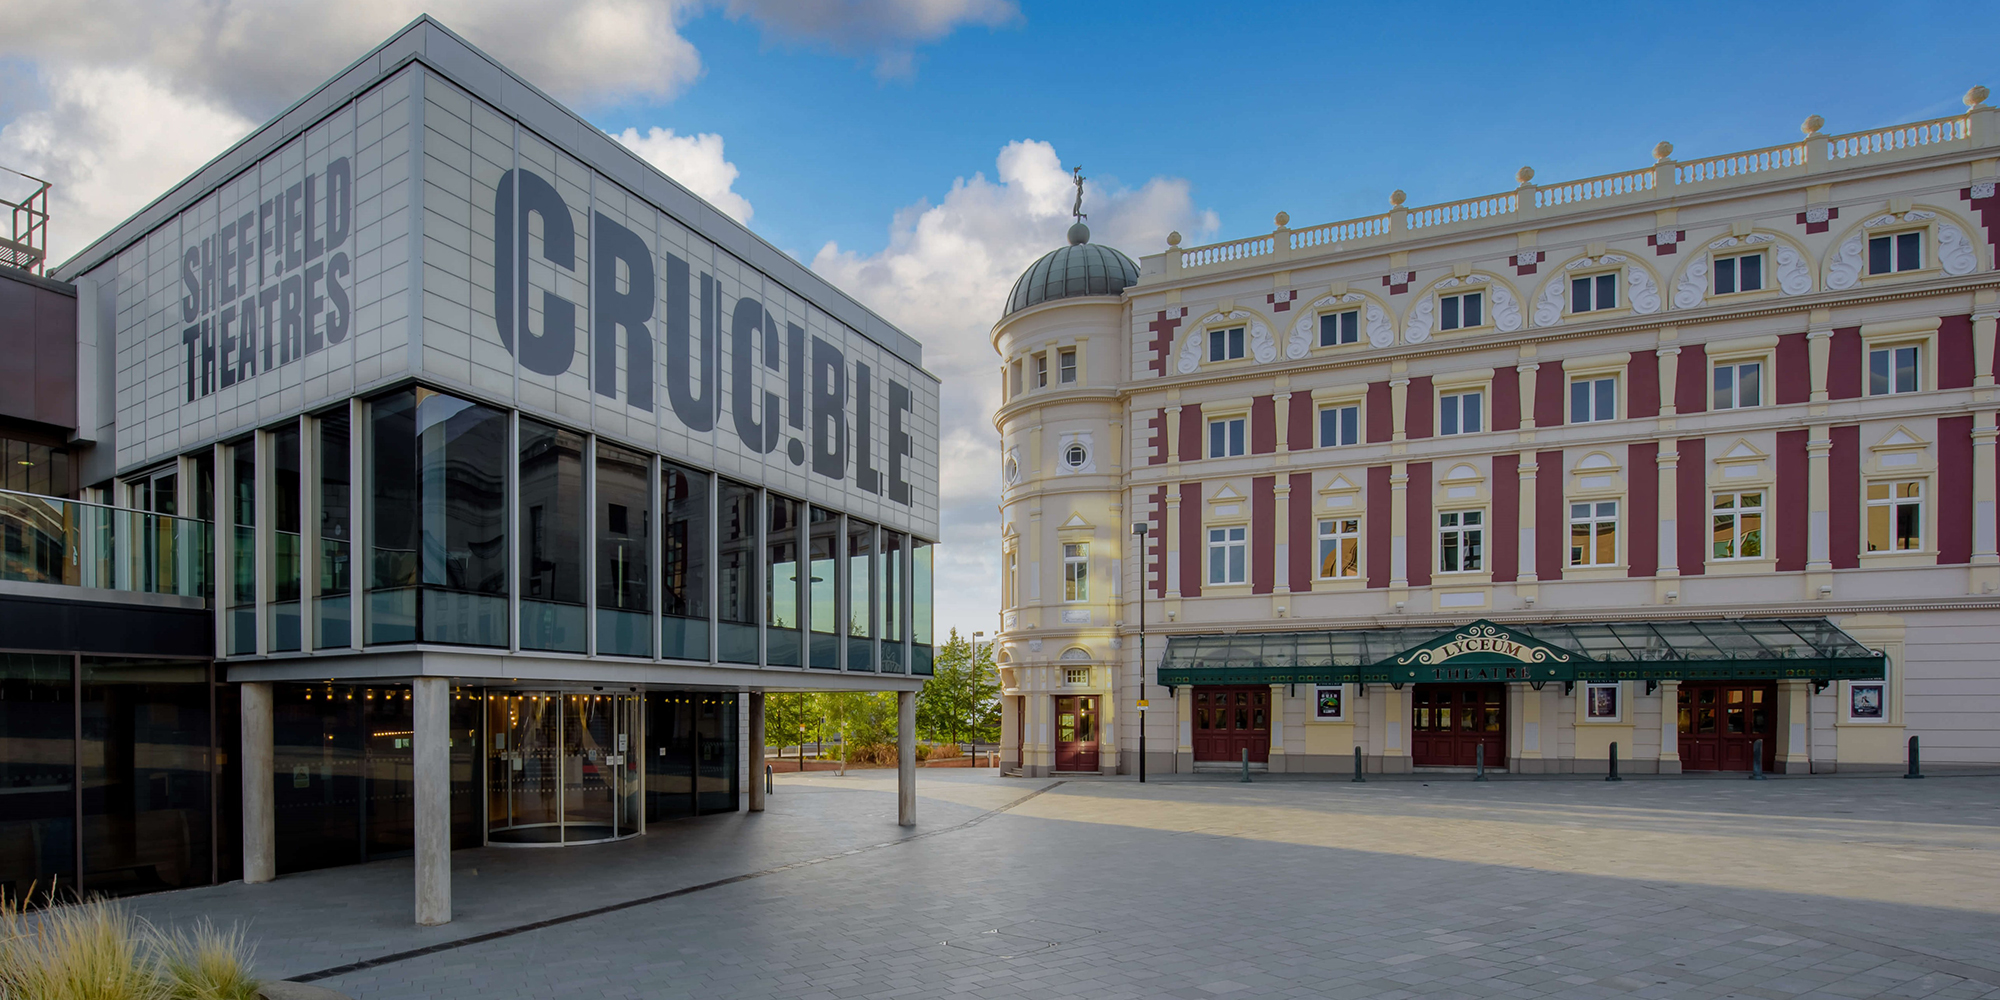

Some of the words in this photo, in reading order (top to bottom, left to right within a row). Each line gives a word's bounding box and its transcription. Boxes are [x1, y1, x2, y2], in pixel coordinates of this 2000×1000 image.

[182, 251, 351, 403] THEATRES
[1441, 638, 1523, 658] LYCEUM
[1431, 666, 1532, 681] THEATRE
